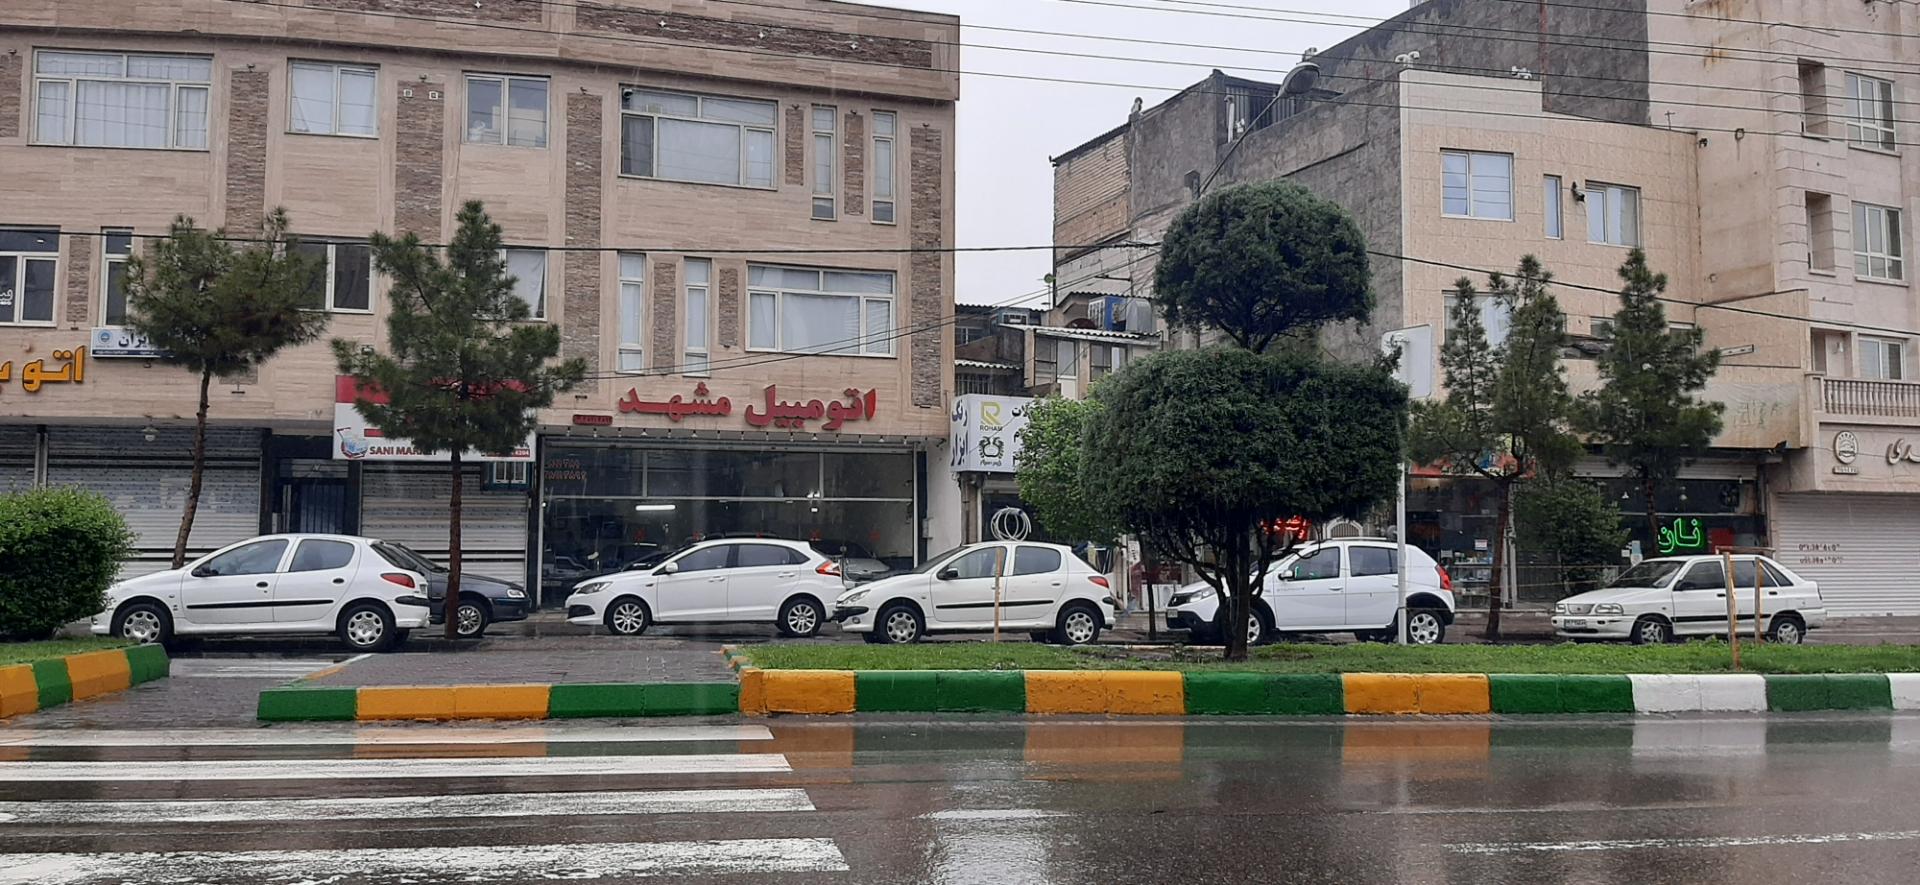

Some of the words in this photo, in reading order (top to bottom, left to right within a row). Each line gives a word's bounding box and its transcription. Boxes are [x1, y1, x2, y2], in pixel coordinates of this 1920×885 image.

[618, 381, 732, 423] مشهد
[744, 384, 877, 430] اتومبیل
[369, 446, 394, 456] SANI
[396, 446, 437, 456] MART
[1657, 517, 1701, 553] نان
